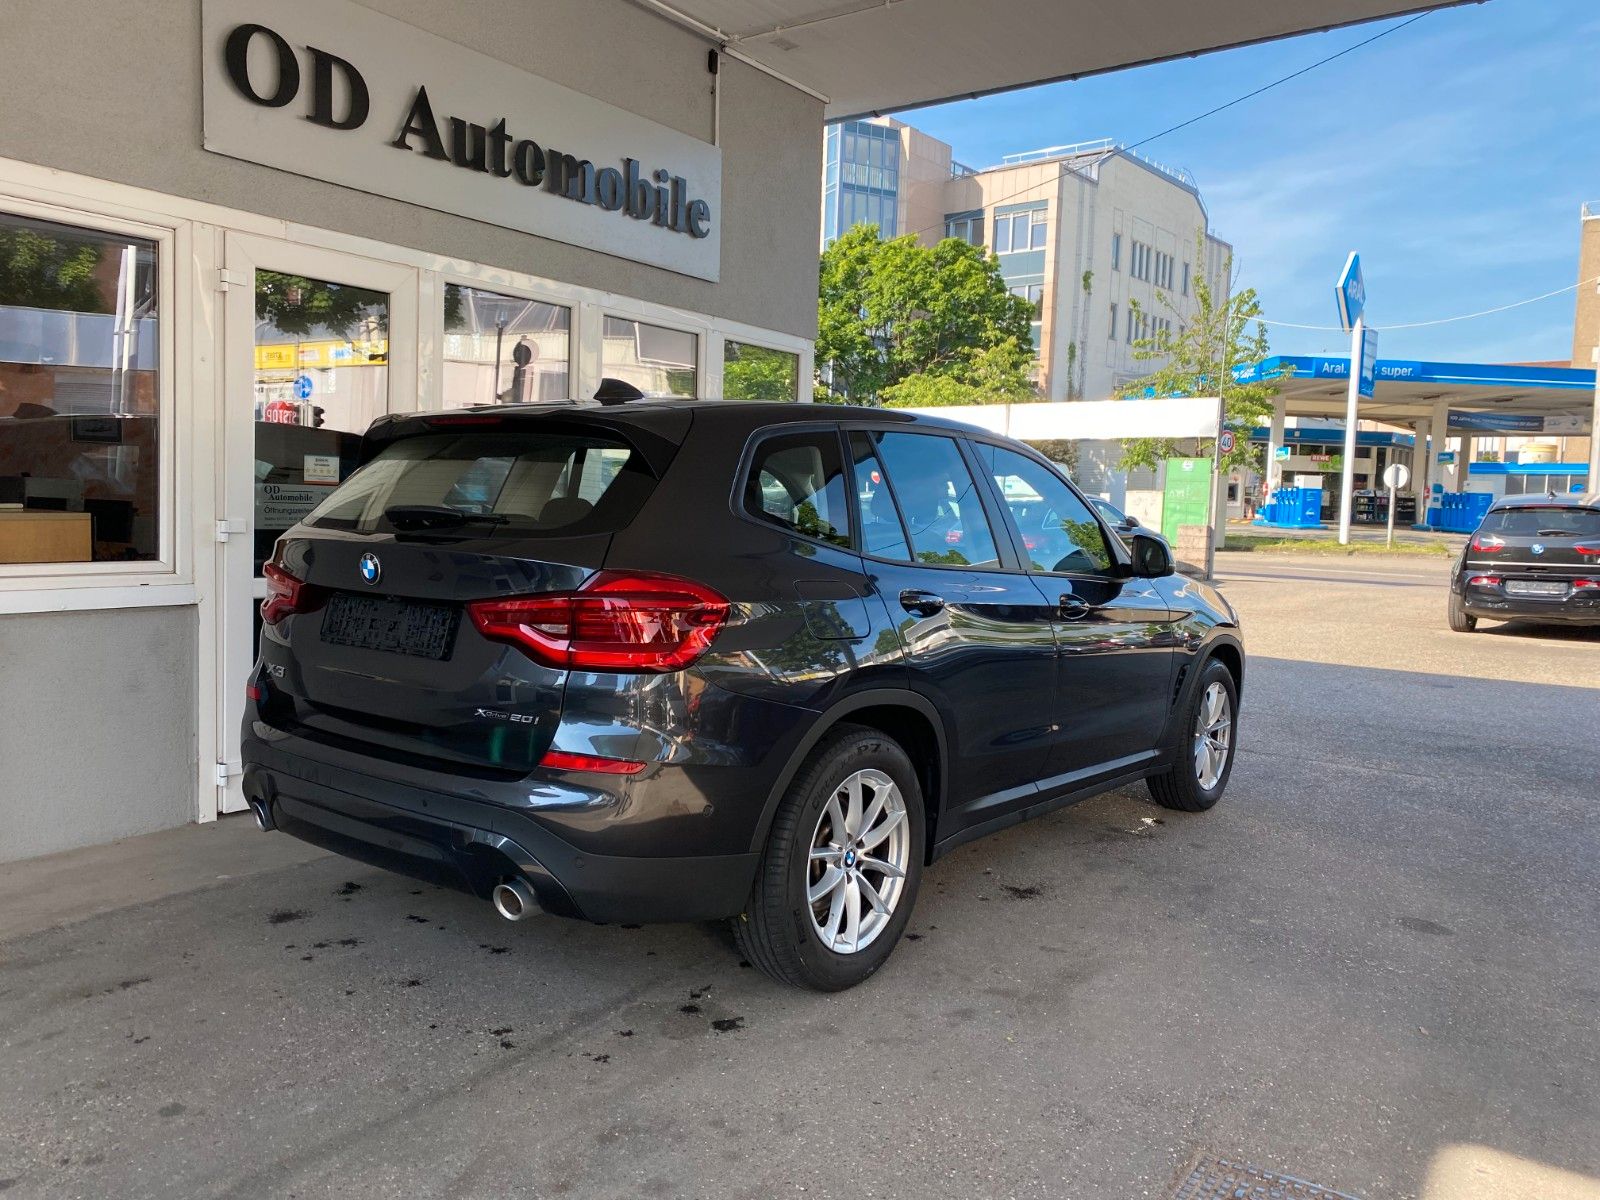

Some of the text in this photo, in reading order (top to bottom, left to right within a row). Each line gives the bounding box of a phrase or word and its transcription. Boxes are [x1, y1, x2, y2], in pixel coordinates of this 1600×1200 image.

[225, 22, 711, 239] OD Automobile
[1322, 361, 1414, 379] Aral. super.
[1221, 436, 1232, 449] 40
[264, 485, 280, 494] OD
[268, 493, 313, 501] Automobile
[266, 662, 285, 678] X3
